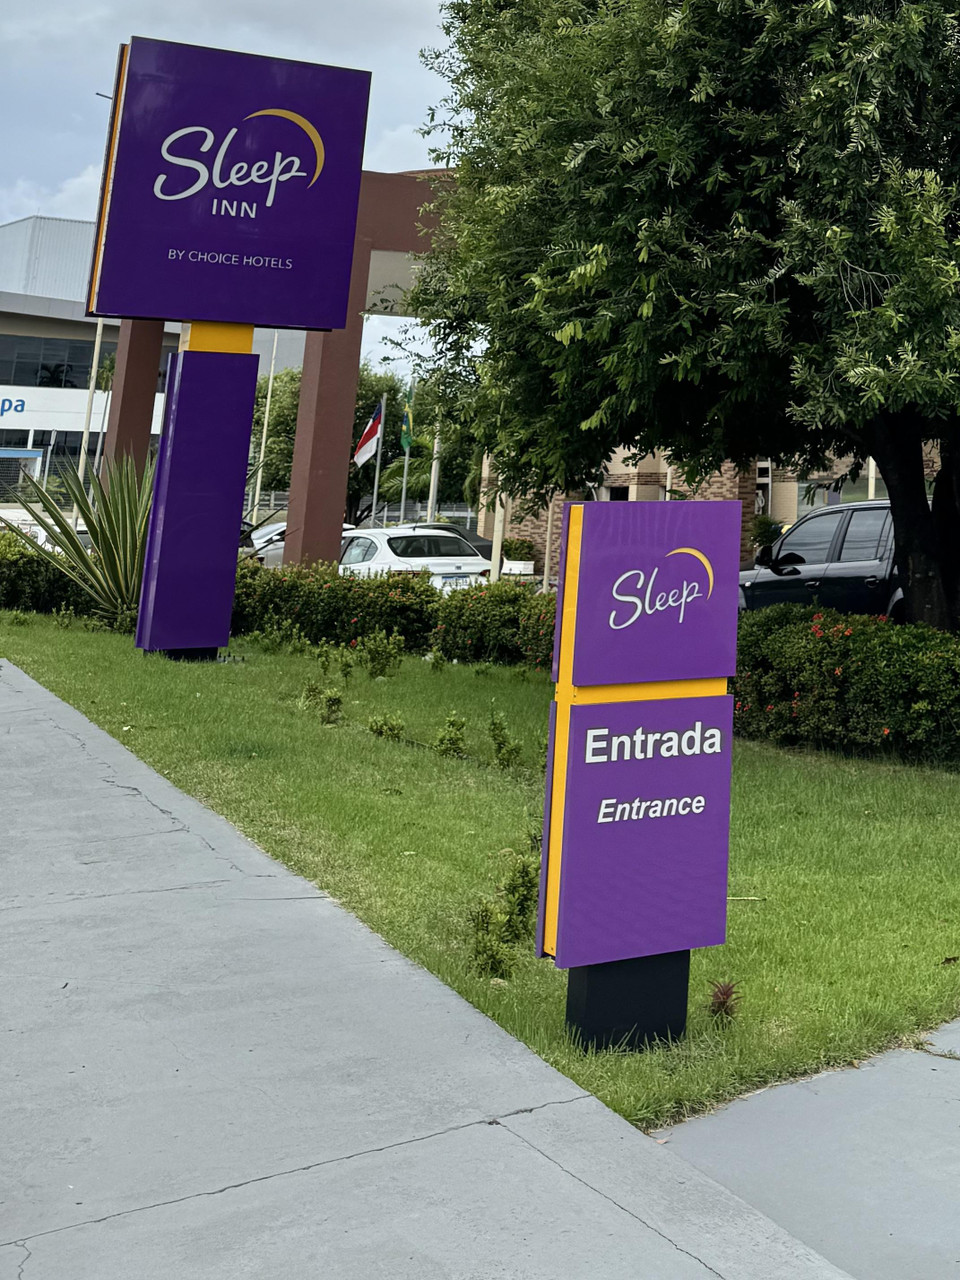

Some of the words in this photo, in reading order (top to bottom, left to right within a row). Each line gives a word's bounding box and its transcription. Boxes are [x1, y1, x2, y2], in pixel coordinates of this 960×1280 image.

[153, 126, 307, 207] Sleep
[212, 198, 257, 218] INN
[168, 249, 185, 260] BY
[188, 251, 239, 265] CHOICE
[243, 256, 293, 269] HOTELS
[609, 567, 703, 629] Sleep
[585, 721, 722, 764] Entrada
[597, 794, 706, 824] Entrance
